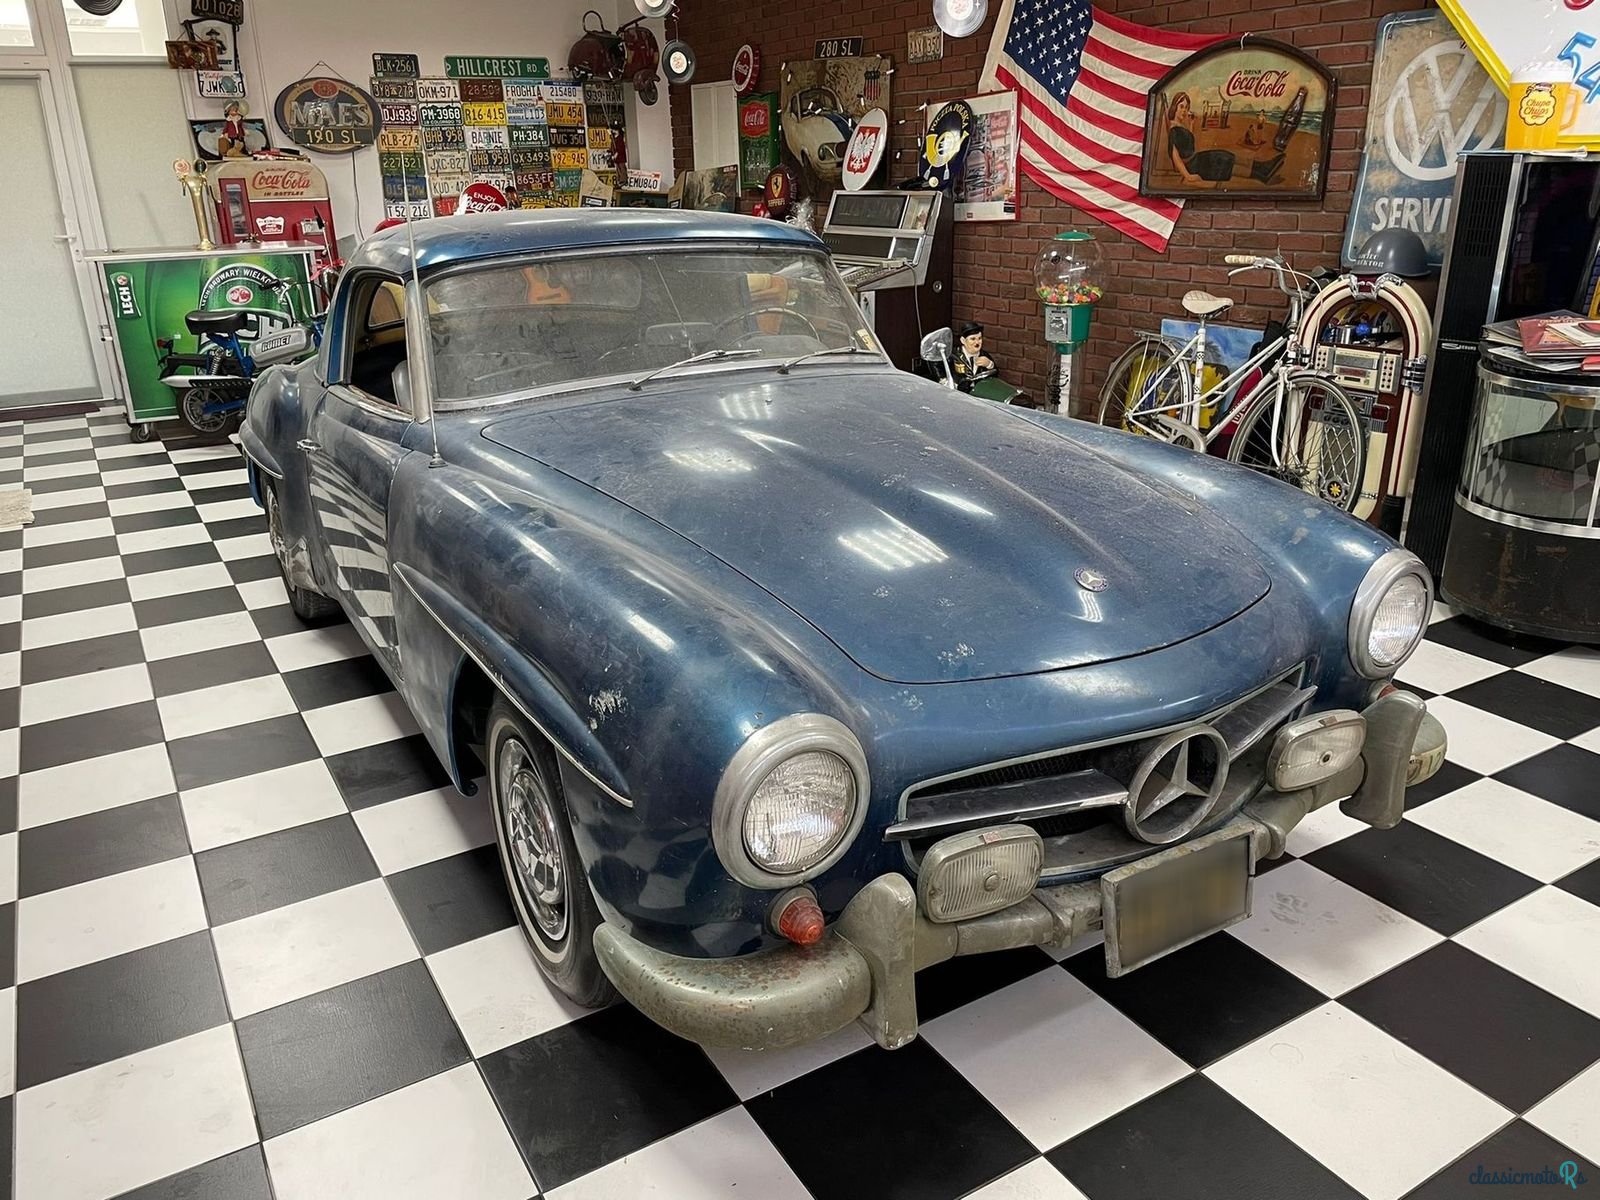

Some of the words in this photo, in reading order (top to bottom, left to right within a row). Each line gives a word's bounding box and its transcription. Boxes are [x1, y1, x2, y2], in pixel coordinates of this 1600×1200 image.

[819, 41, 838, 58] 280
[841, 39, 854, 56] SL
[457, 58, 521, 77] HILLCREST
[1226, 70, 1290, 98] Coca-Cola
[288, 100, 370, 127] MAES
[567, 106, 582, 119] 454
[930, 105, 953, 131] POCZTA
[953, 103, 969, 130] POLSKA
[1523, 106, 1549, 116] Chups
[306, 129, 334, 144] 190
[340, 129, 362, 144] SL
[446, 129, 463, 142] 958
[491, 151, 509, 165] 958
[571, 152, 586, 165] 945
[252, 170, 312, 191] Coca-Cola
[473, 191, 496, 203] ENJOY
[395, 205, 405, 217] 52
[412, 205, 428, 217] 216
[209, 268, 241, 292] BROWARY
[118, 286, 134, 315] LECH
